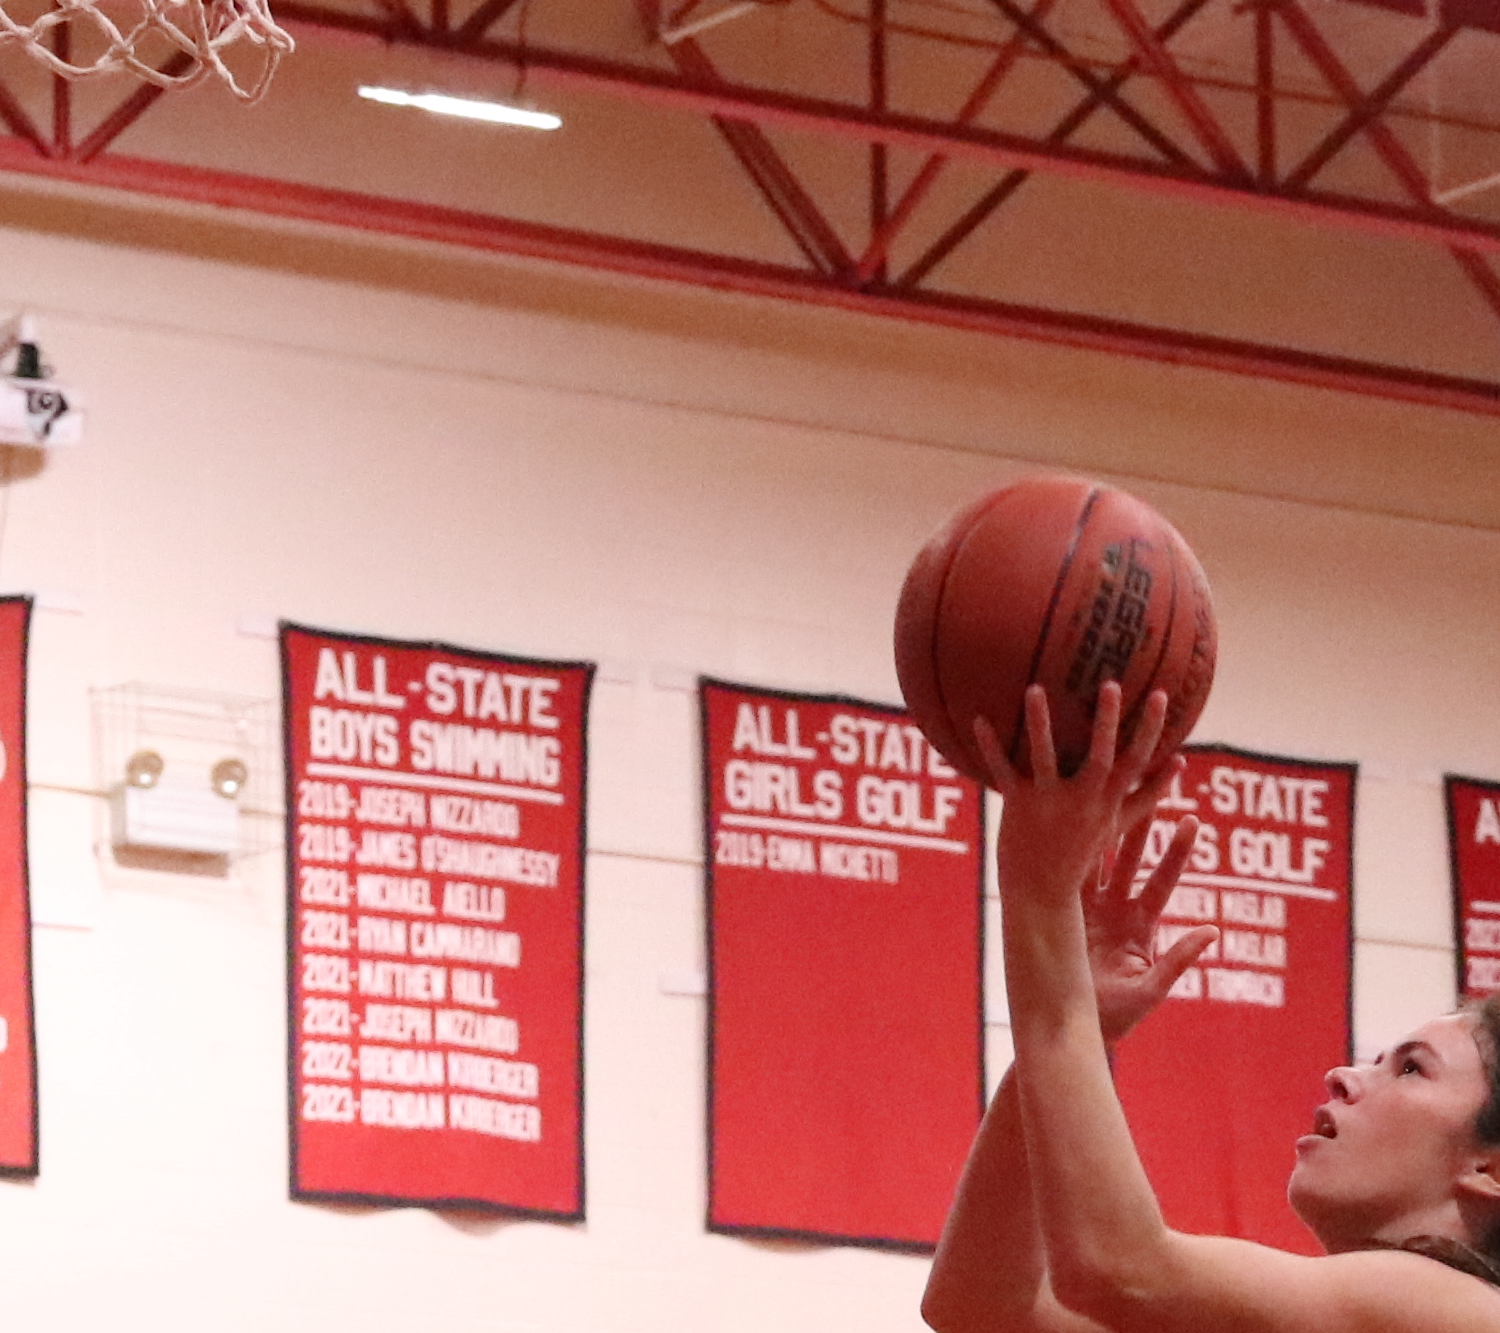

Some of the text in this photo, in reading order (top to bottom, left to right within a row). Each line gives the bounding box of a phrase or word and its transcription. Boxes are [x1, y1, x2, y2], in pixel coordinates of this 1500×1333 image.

[314, 648, 562, 730] ALL-STATE
[309, 705, 562, 787] BOYS SWIMMING
[732, 702, 960, 779] ALL-STATE
[724, 758, 964, 834] GIRLS GOLF
[1156, 766, 1330, 828] L-STATE
[1229, 827, 1331, 884] GOLF
